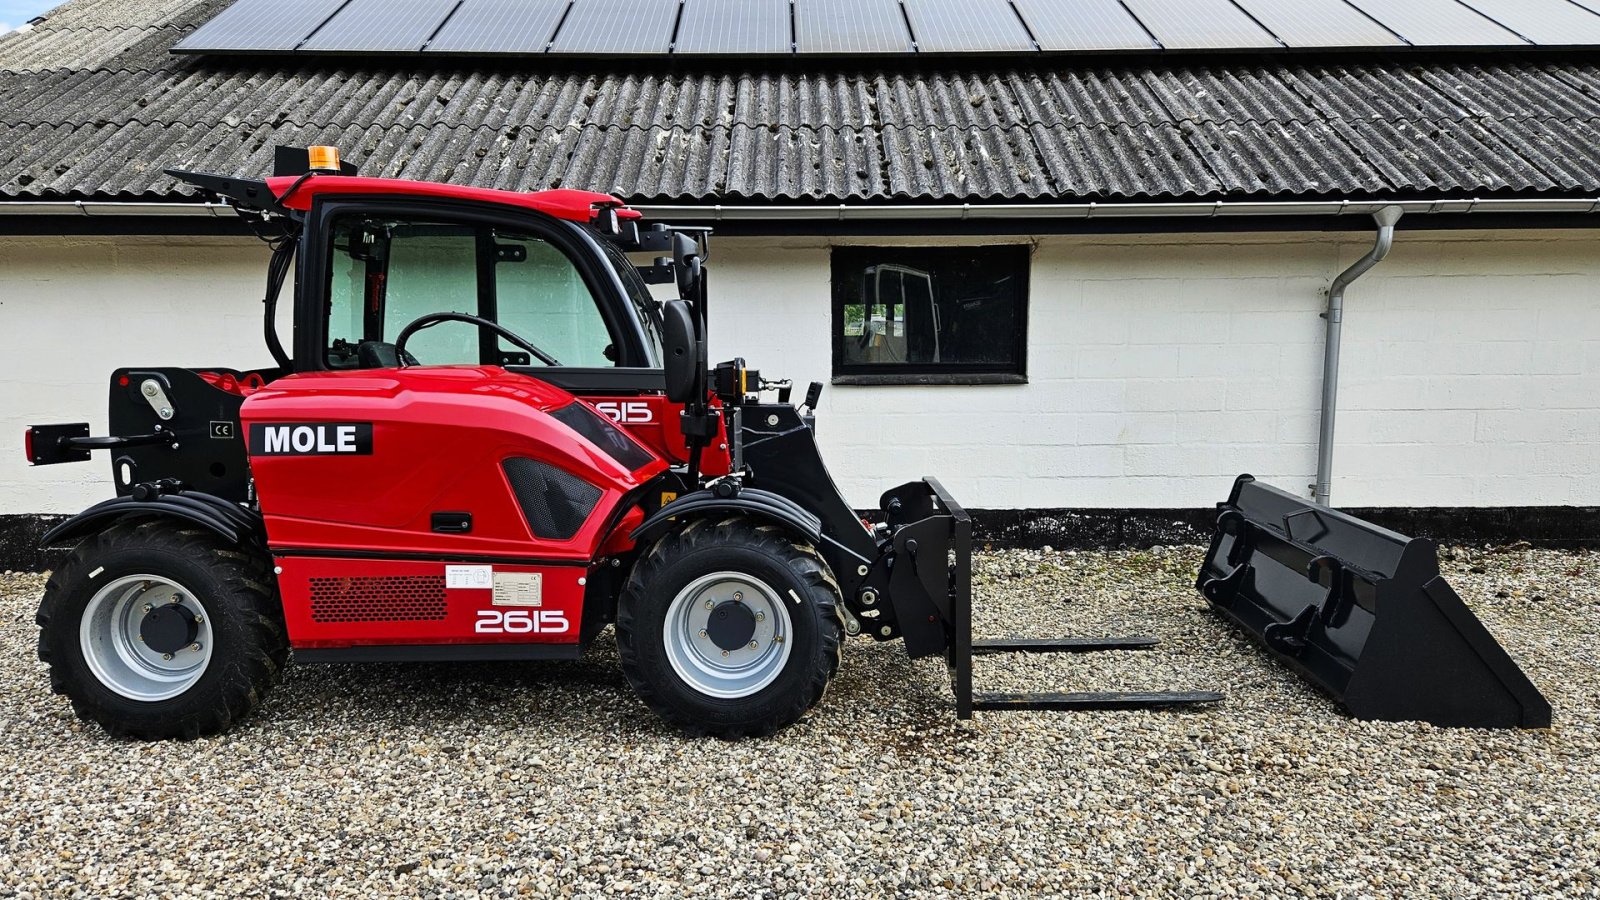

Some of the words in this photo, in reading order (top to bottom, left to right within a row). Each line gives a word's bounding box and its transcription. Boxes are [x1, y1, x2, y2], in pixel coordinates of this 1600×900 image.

[589, 402, 653, 422] 615
[215, 425, 229, 435] CE
[264, 426, 357, 453] MOLE
[475, 610, 570, 633] 2615
